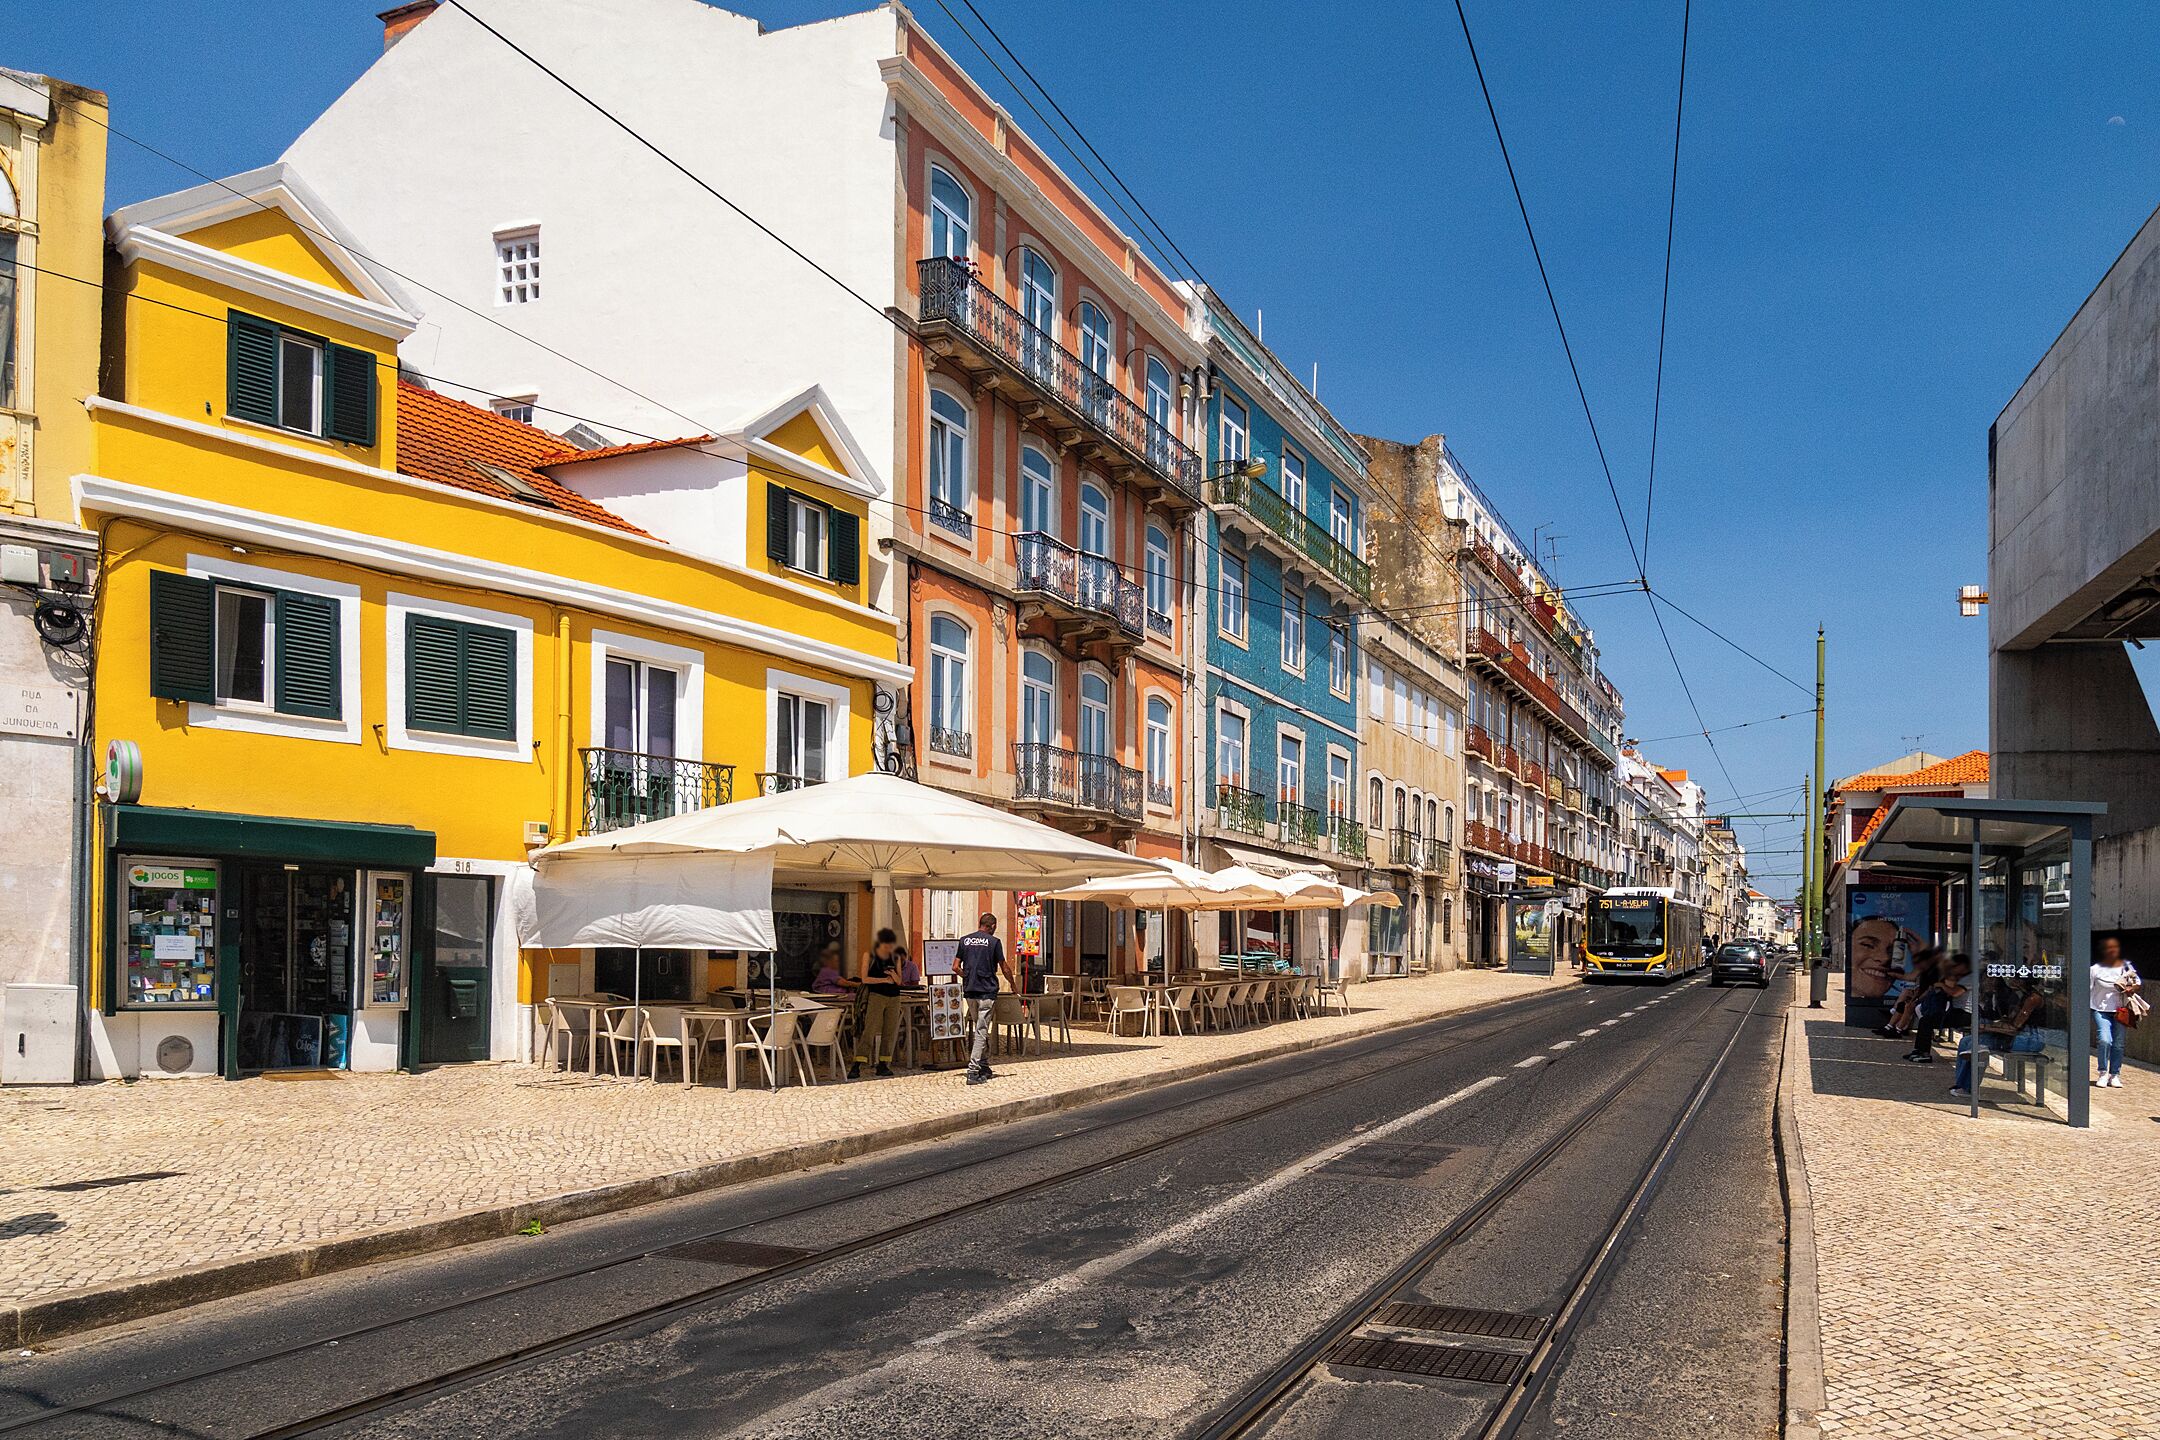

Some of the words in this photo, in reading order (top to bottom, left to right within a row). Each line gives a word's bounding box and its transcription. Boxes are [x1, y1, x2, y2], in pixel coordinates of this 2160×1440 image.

[21, 690, 42, 700] RUA
[25, 704, 39, 713] DA
[2, 717, 59, 730] JUNQUEIRA
[455, 860, 471, 873] 518
[151, 871, 180, 881] JOGOS
[1598, 899, 1613, 909] 751
